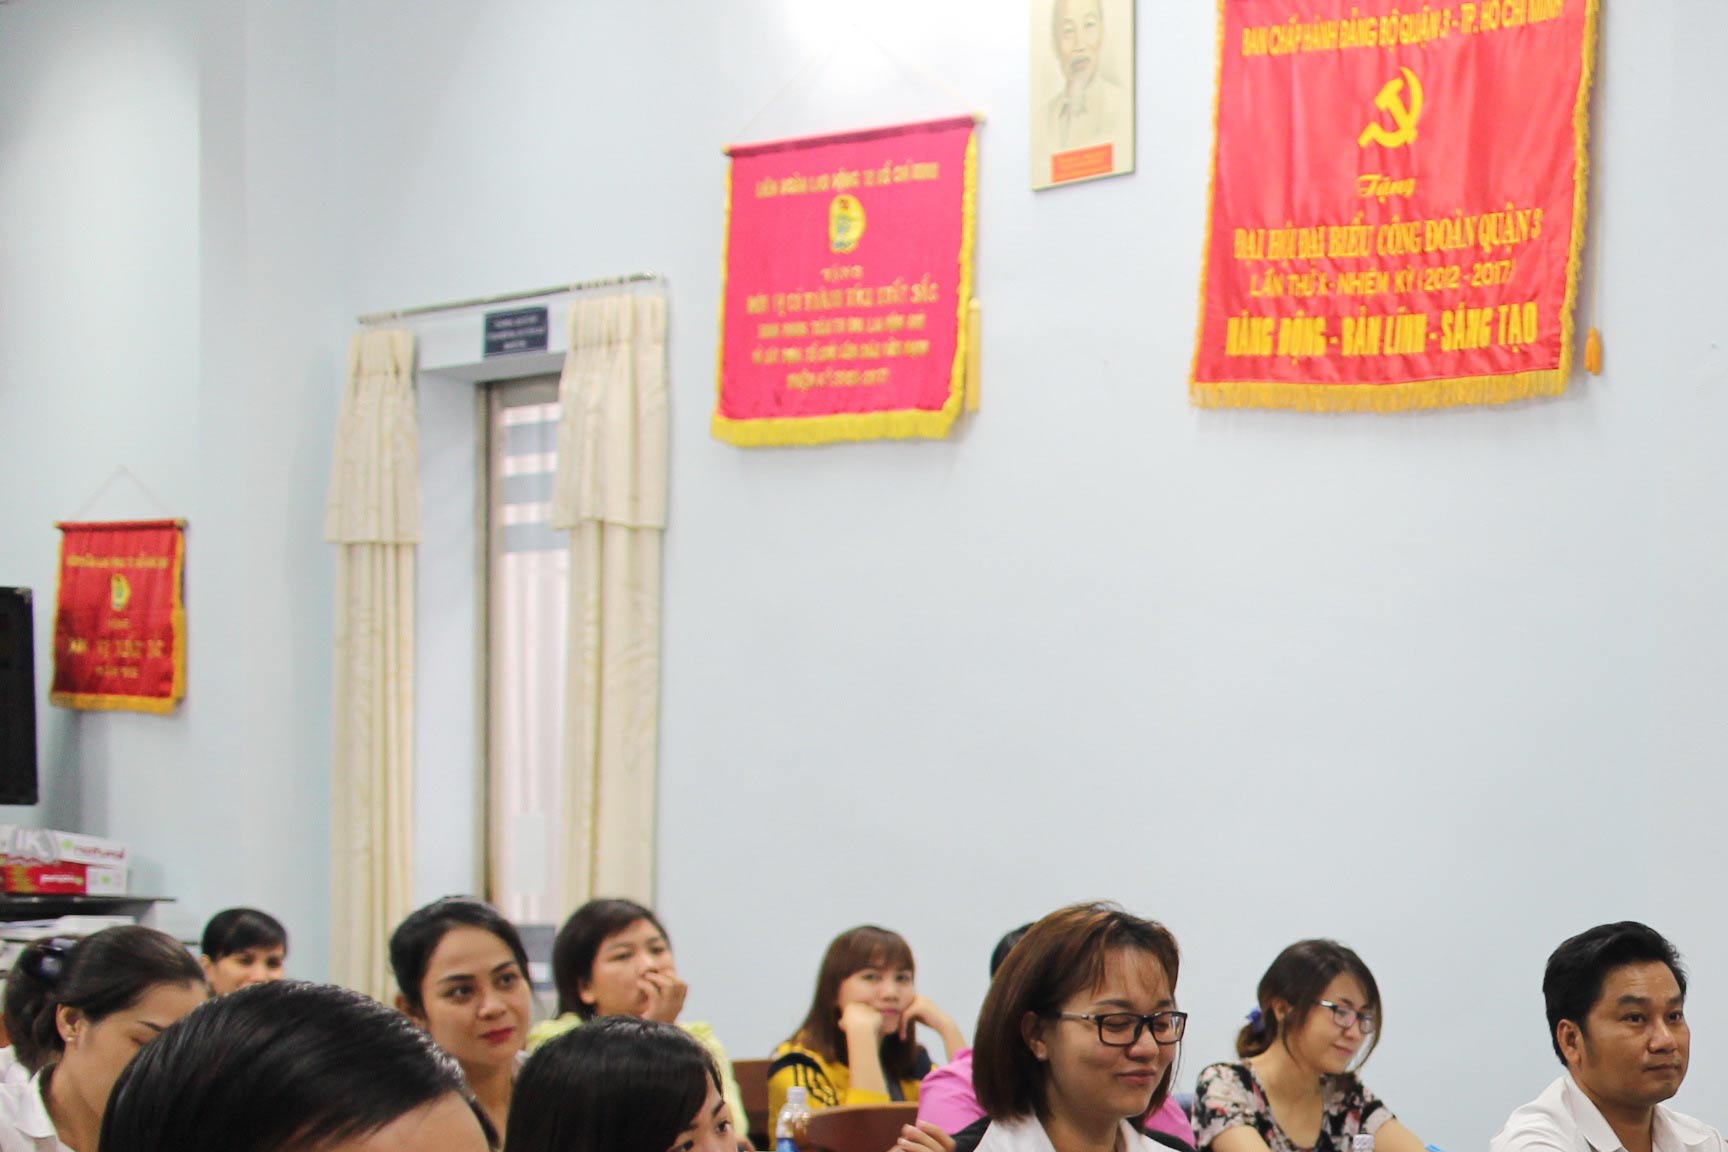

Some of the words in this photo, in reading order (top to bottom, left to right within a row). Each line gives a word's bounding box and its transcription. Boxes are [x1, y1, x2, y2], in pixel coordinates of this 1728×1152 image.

[1377, 214, 1422, 256] CÔNG
[1424, 207, 1478, 252] ĐOÀN
[1478, 201, 1532, 253] QUẬN
[1531, 207, 1544, 239] 3
[1440, 301, 1493, 352] SÁNG
[1497, 301, 1538, 353] TẠO
